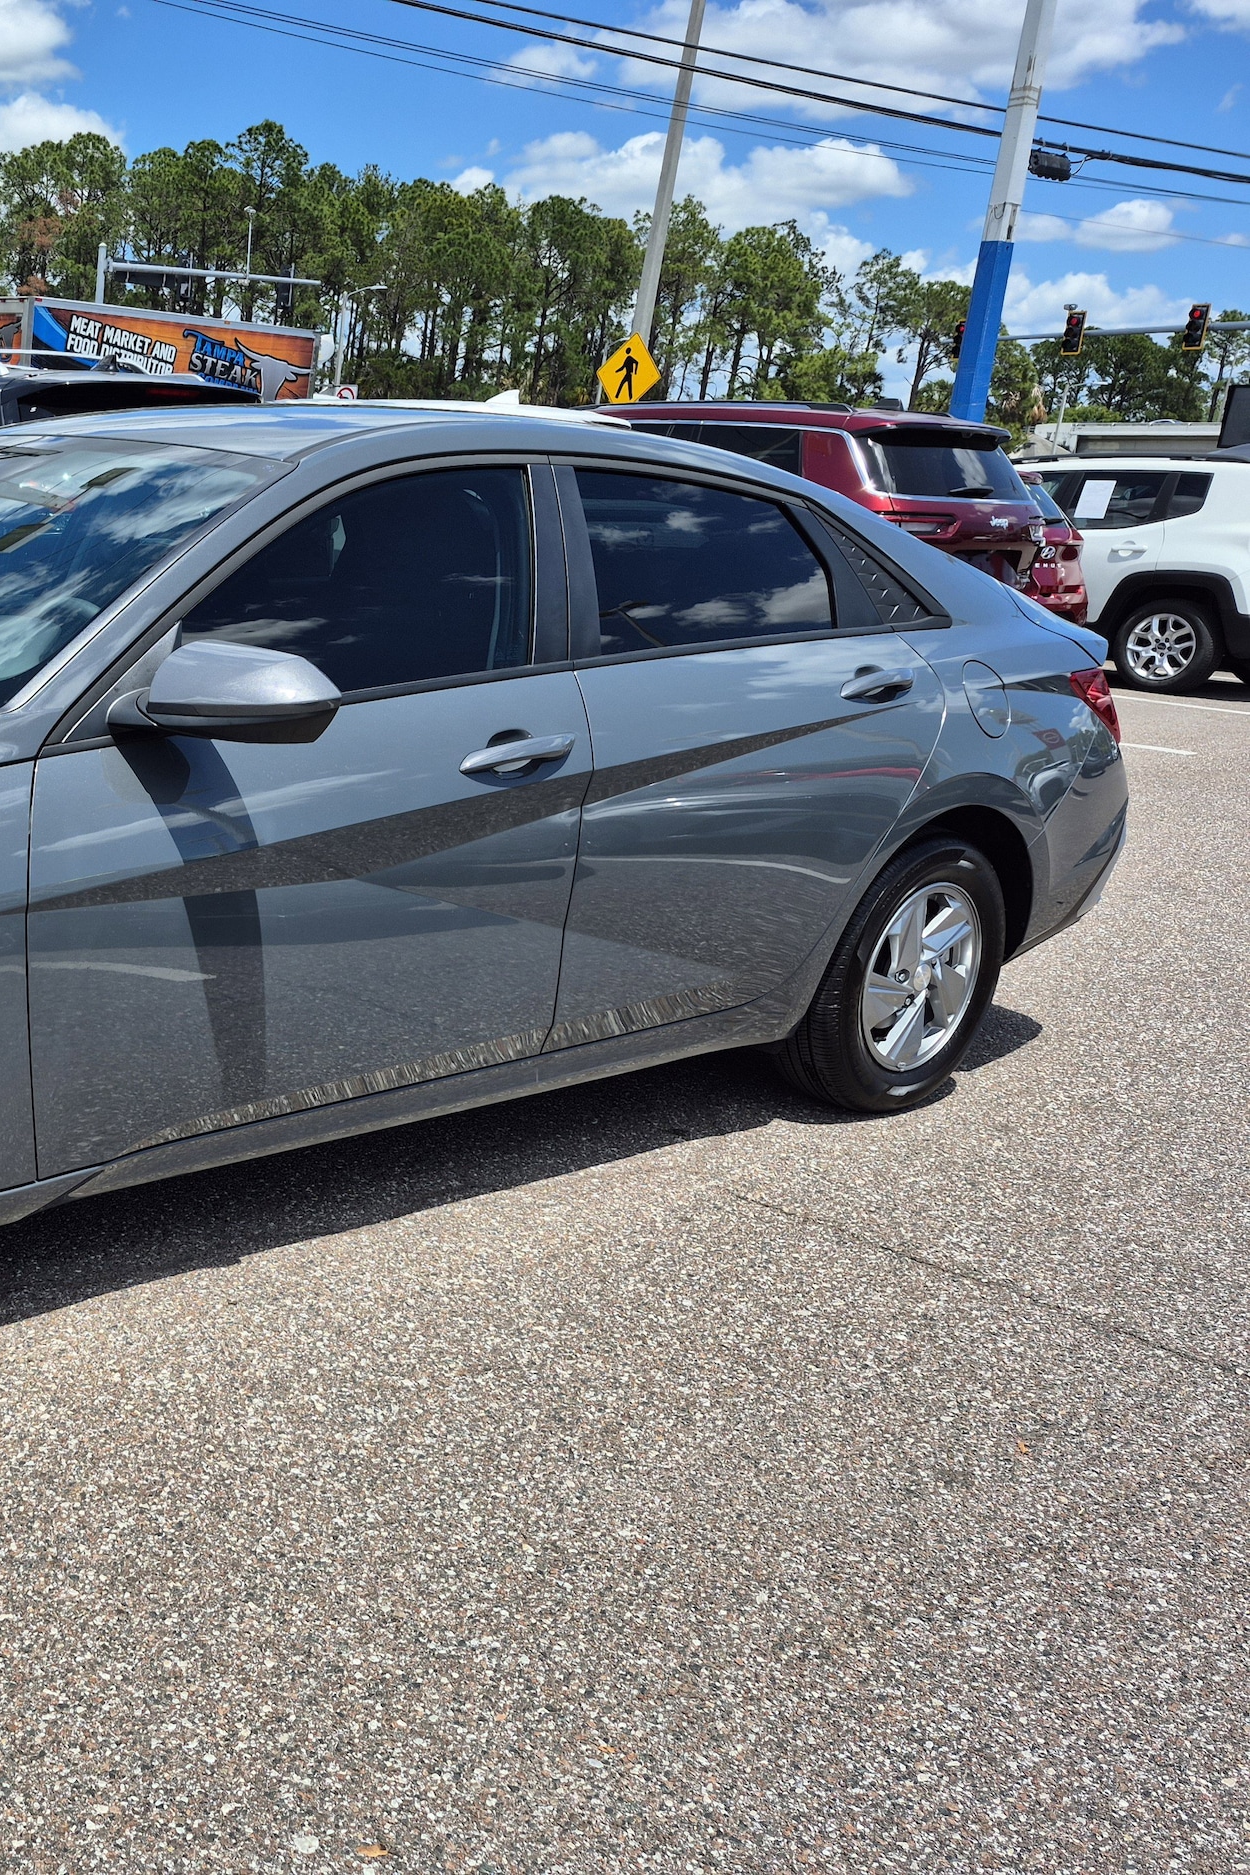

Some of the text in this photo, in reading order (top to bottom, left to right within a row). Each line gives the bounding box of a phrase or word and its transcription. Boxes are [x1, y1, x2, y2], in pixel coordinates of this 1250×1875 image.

[66, 333, 99, 358] FOOD
[70, 315, 176, 363] MEAT MARKET AND
[184, 330, 245, 366] TAMPA
[190, 353, 258, 388] STEAK
[989, 515, 1009, 530] Jeep
